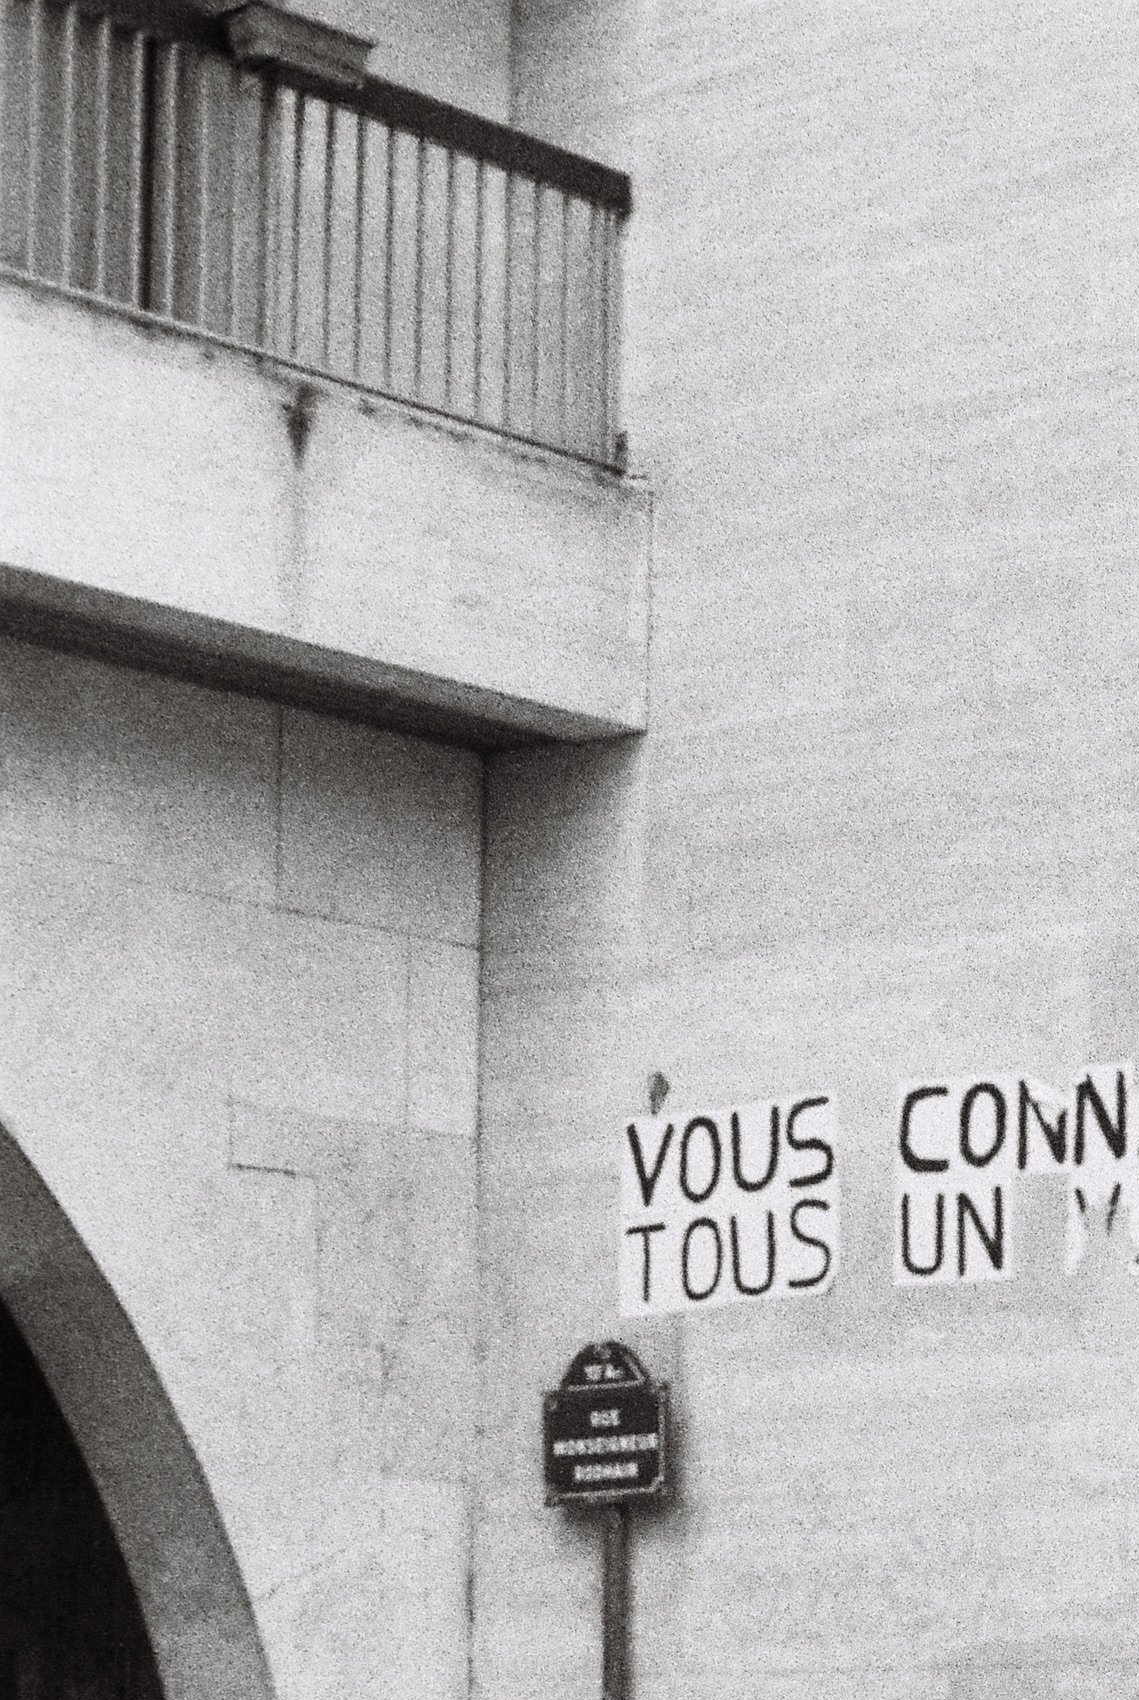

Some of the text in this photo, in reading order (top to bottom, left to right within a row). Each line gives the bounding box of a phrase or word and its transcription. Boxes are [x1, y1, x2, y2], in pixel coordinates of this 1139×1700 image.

[627, 1096, 834, 1207] VOUS
[625, 1199, 832, 1302] TOUS
[901, 1186, 1004, 1276] UN
